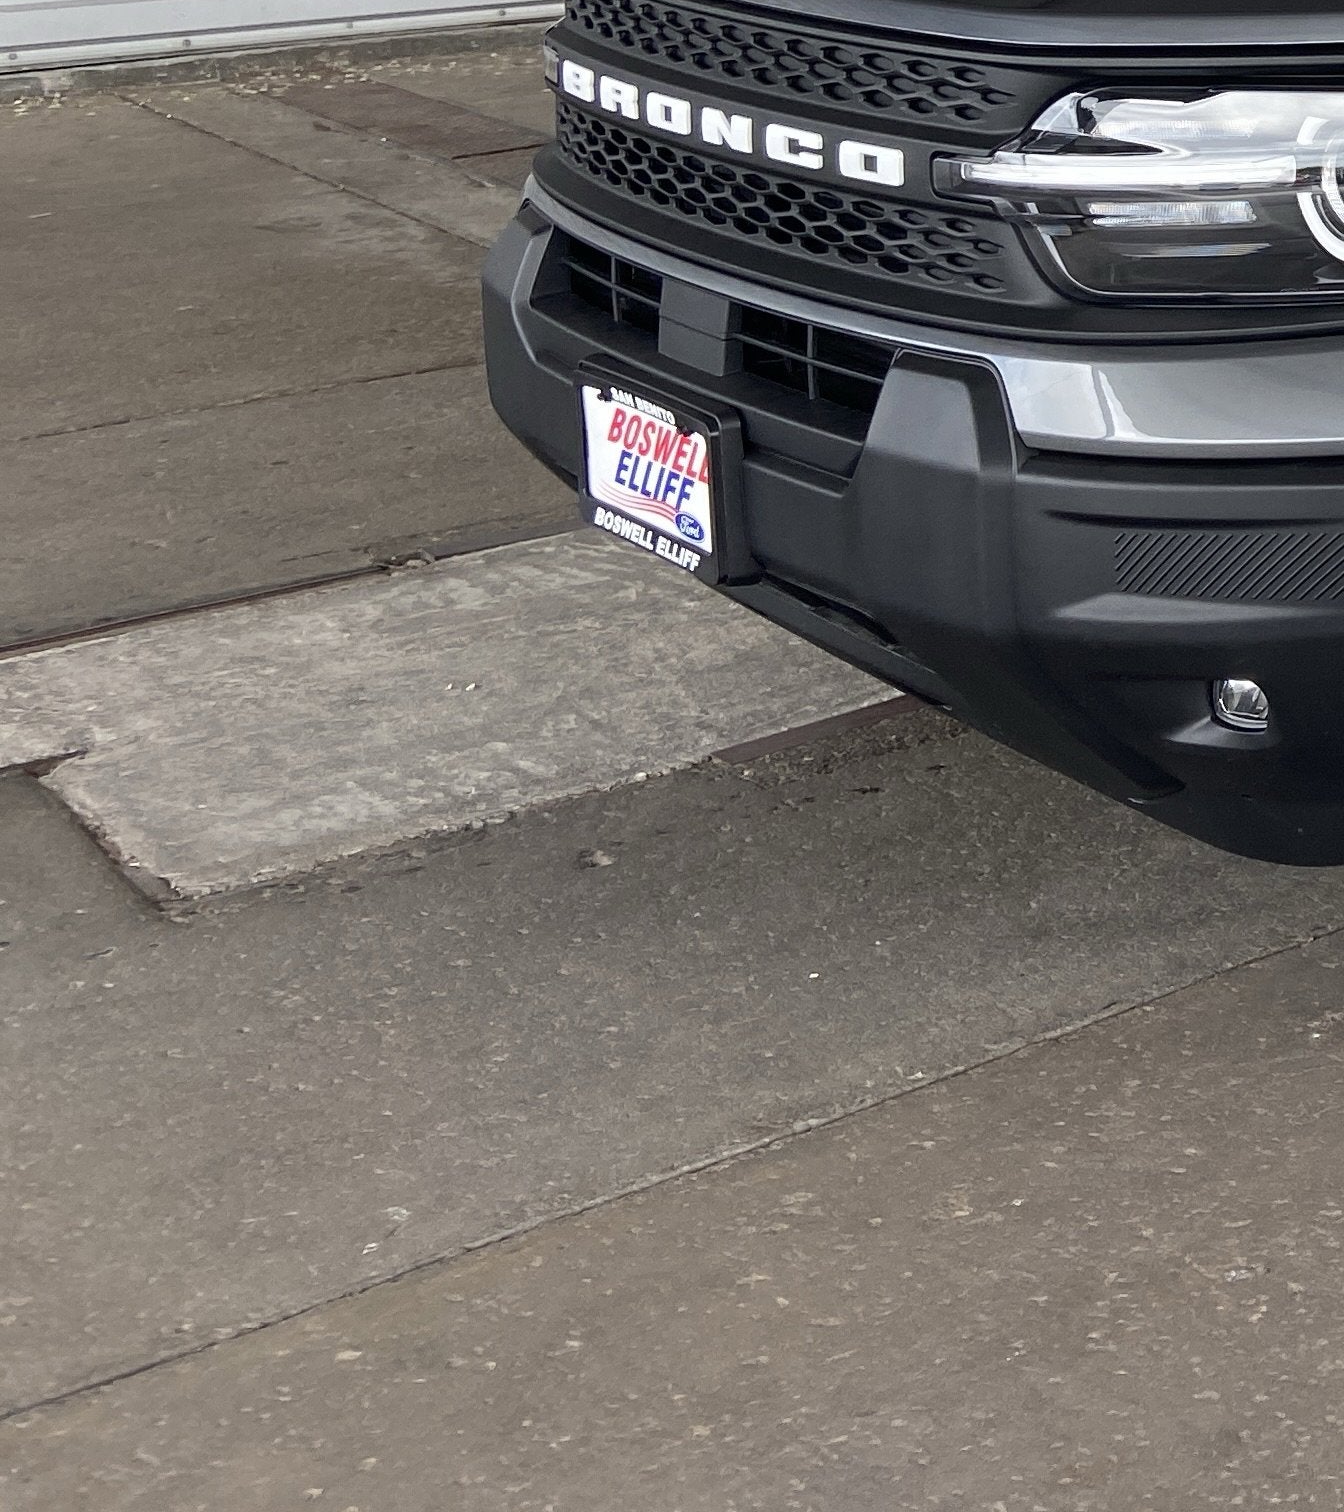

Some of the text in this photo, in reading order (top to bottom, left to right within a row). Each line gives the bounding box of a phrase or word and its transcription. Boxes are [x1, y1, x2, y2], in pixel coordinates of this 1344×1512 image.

[563, 59, 905, 187] BRONCO
[615, 450, 696, 513] ELLIFF
[594, 506, 701, 572] BOSWELL ELLIFF
[680, 515, 701, 539] Ford
